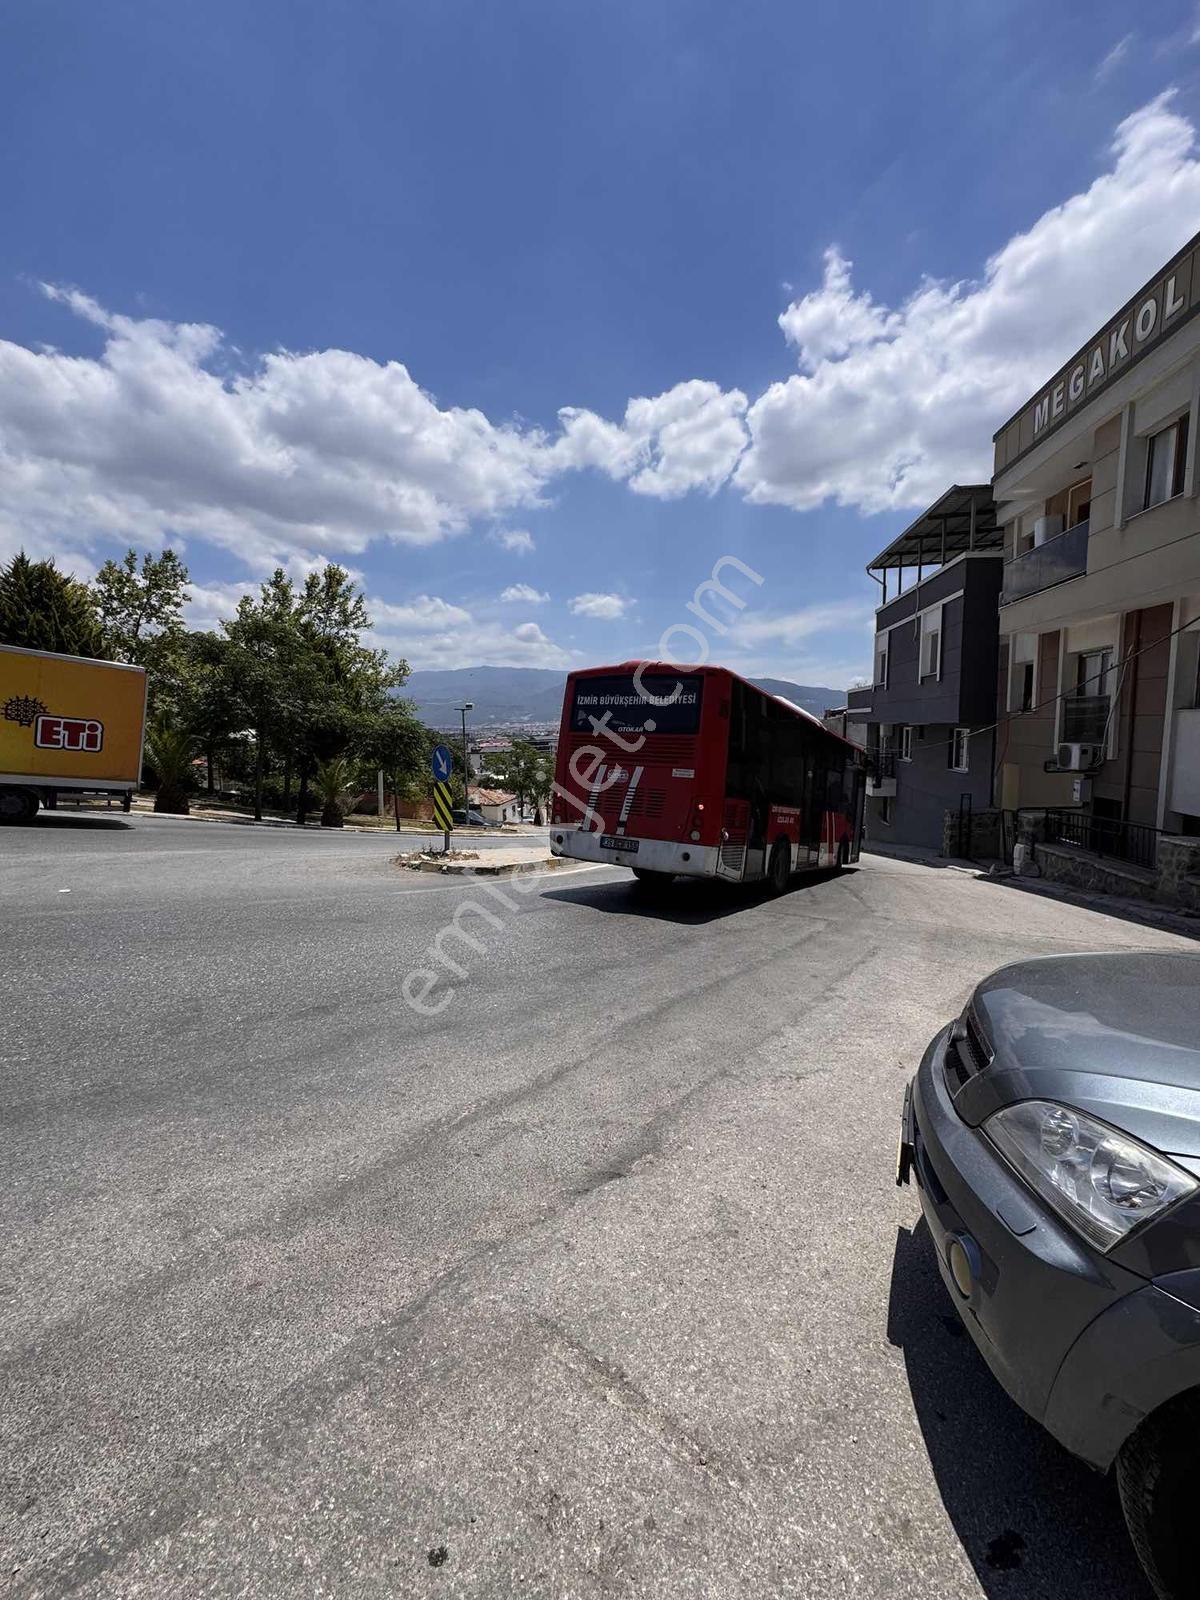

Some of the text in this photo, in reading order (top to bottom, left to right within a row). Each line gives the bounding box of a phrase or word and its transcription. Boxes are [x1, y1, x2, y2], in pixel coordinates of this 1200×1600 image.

[1033, 275, 1185, 434] MEGAKOL
[576, 694, 599, 705] İZMİR
[648, 692, 697, 706] BELEDİYESİ
